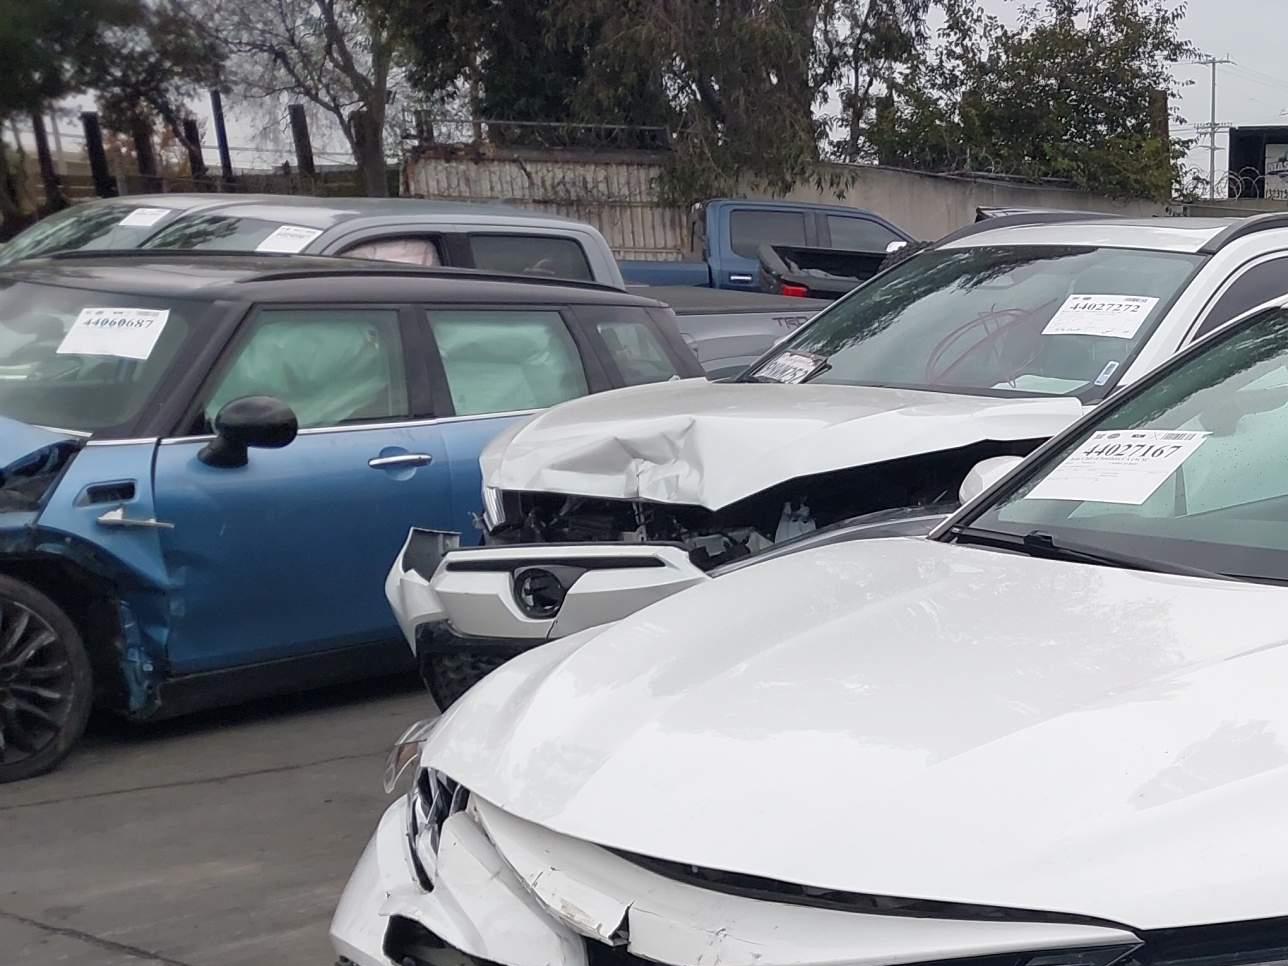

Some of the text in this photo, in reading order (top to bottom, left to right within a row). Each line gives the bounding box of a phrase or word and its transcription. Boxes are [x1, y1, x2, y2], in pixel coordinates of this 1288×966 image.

[1070, 302, 1141, 313] 44027272
[84, 318, 154, 329] 44060687
[1083, 443, 1183, 458] 44027167
